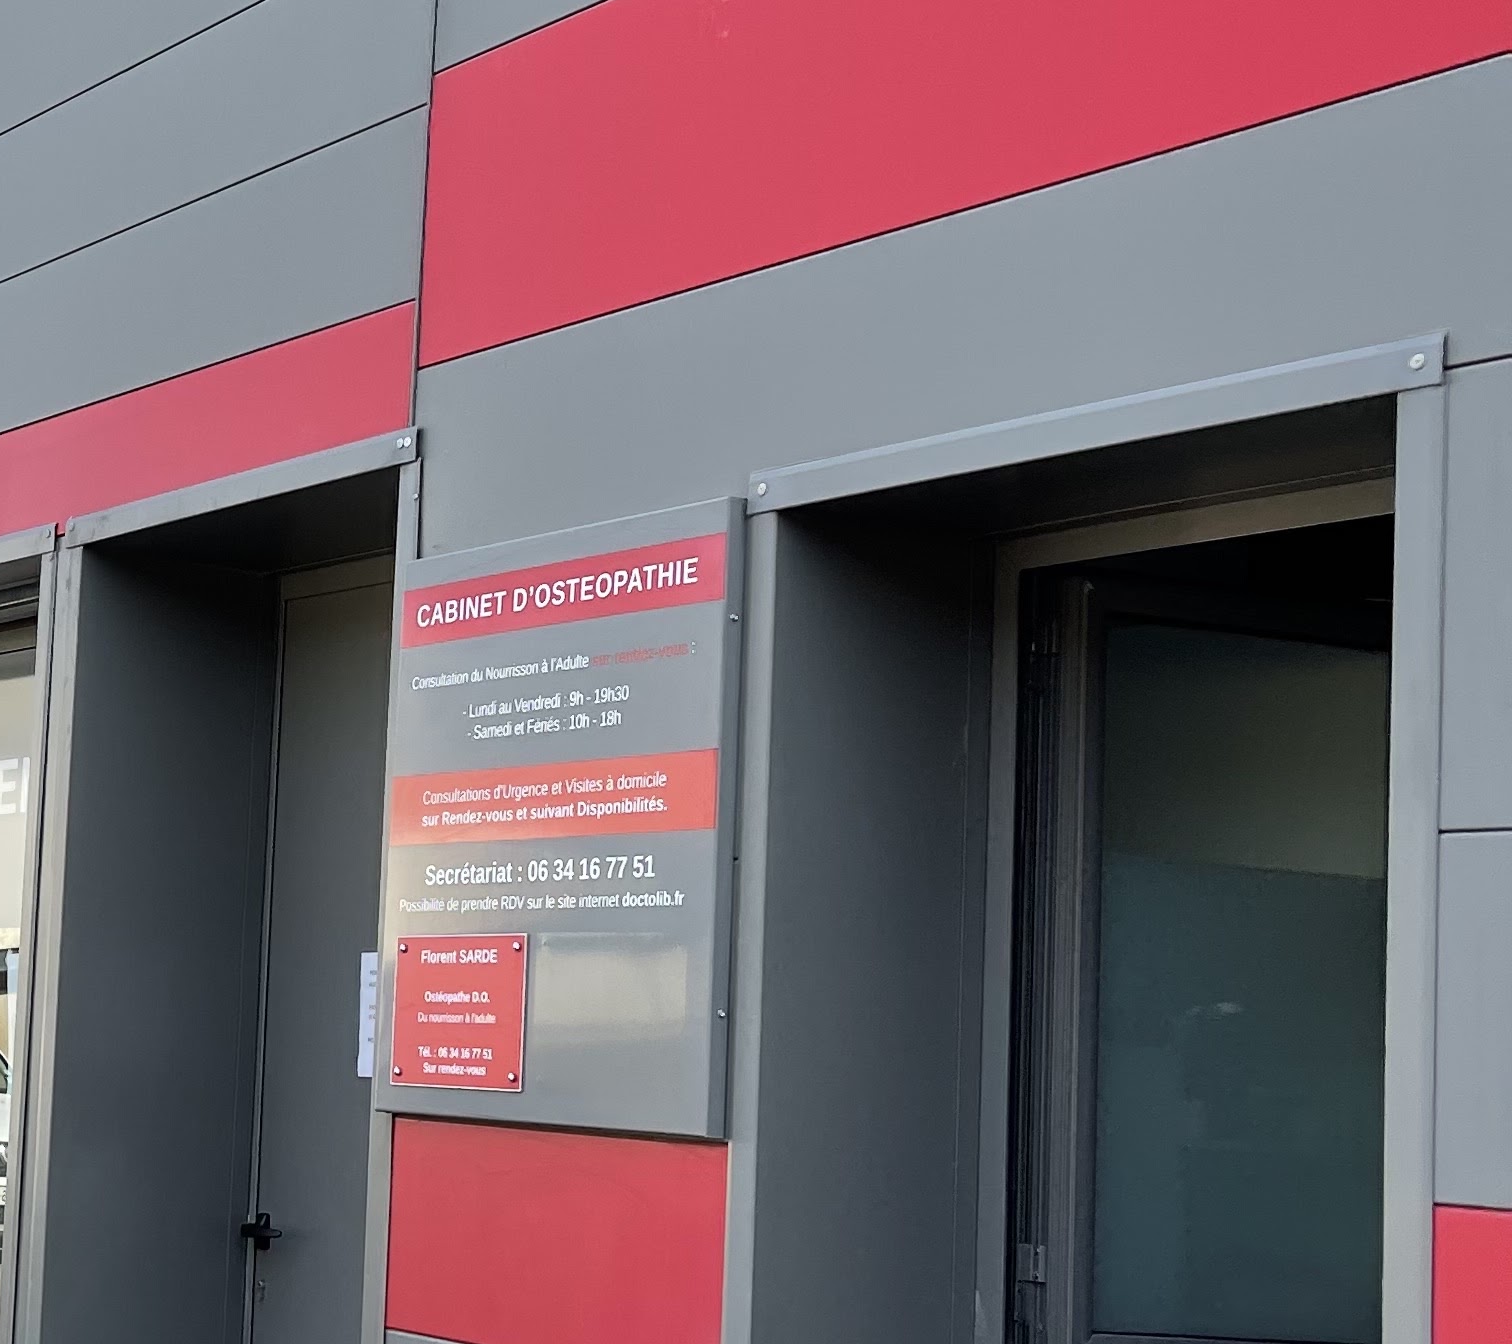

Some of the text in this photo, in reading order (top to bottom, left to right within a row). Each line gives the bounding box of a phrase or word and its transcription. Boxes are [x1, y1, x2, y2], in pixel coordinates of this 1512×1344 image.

[416, 557, 699, 628] CABINET D'OSTEOPATHIE
[411, 670, 469, 691] Consultation
[470, 668, 484, 682] du
[485, 662, 539, 680] Nourrisson
[541, 659, 549, 674] à
[550, 653, 590, 672] l'Adulte
[468, 703, 497, 718] Lundi
[498, 702, 512, 715] au
[514, 692, 561, 713] Vendredi
[569, 690, 584, 707] 9h
[594, 685, 630, 704] 19h30
[473, 722, 513, 740] Samedi
[514, 721, 525, 735] et
[526, 715, 560, 733] Fériés
[569, 712, 590, 730] 10h
[599, 709, 622, 727] 18h
[422, 771, 668, 806] Consultations d'Urgence et Visites à domicile
[421, 796, 668, 827] sur Rendez-vous et suivant Disponibilités.
[424, 859, 513, 886] Secrétariat
[527, 859, 549, 882] 06
[552, 858, 575, 881] 34
[579, 857, 601, 880] 16
[605, 855, 628, 879] 77
[632, 854, 656, 878] 51
[399, 889, 686, 914] Possibilité de prendre RDV sur le site internet doctolib.fr
[420, 948, 498, 964] Florent SARDE
[424, 991, 491, 1005] Ostéopathe D.O.
[418, 1012, 428, 1023] Du
[429, 1013, 464, 1023] nourrisson
[471, 1012, 496, 1024] l'adulte
[423, 1062, 487, 1076] Sur rendez-vous
[438, 1047, 448, 1058] 06
[449, 1047, 459, 1059] 34
[471, 1048, 481, 1059] 77
[482, 1048, 493, 1060] 51
